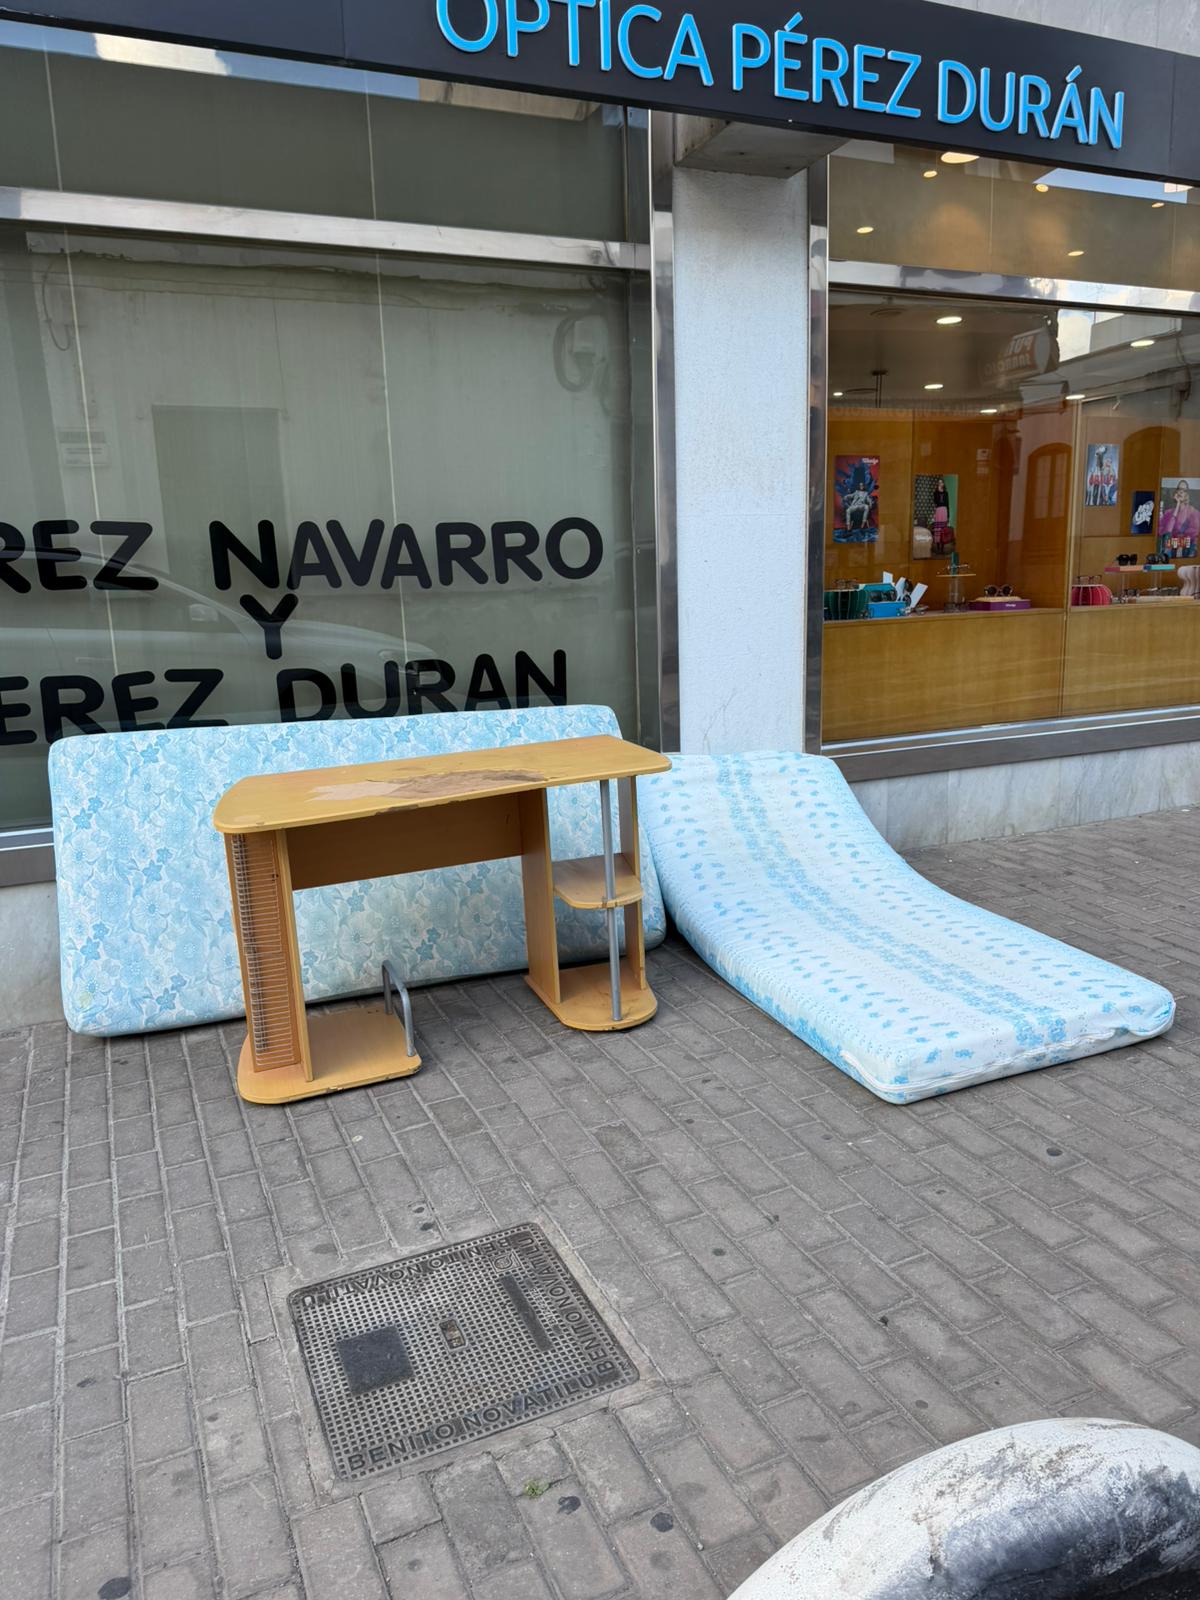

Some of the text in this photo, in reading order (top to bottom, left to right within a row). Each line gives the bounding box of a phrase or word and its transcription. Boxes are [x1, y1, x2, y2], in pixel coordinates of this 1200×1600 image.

[731, 12, 922, 118] PÉREZ
[938, 64, 1125, 149] DURÁN
[209, 517, 604, 591] NAVARRO
[240, 594, 299, 660] Y
[277, 649, 568, 723] DURAN
[302, 1237, 509, 1306] BENITO NOVATILU
[518, 1236, 615, 1374] BENITO NOVATILU
[348, 1375, 598, 1471] BENITO NOVATILU
